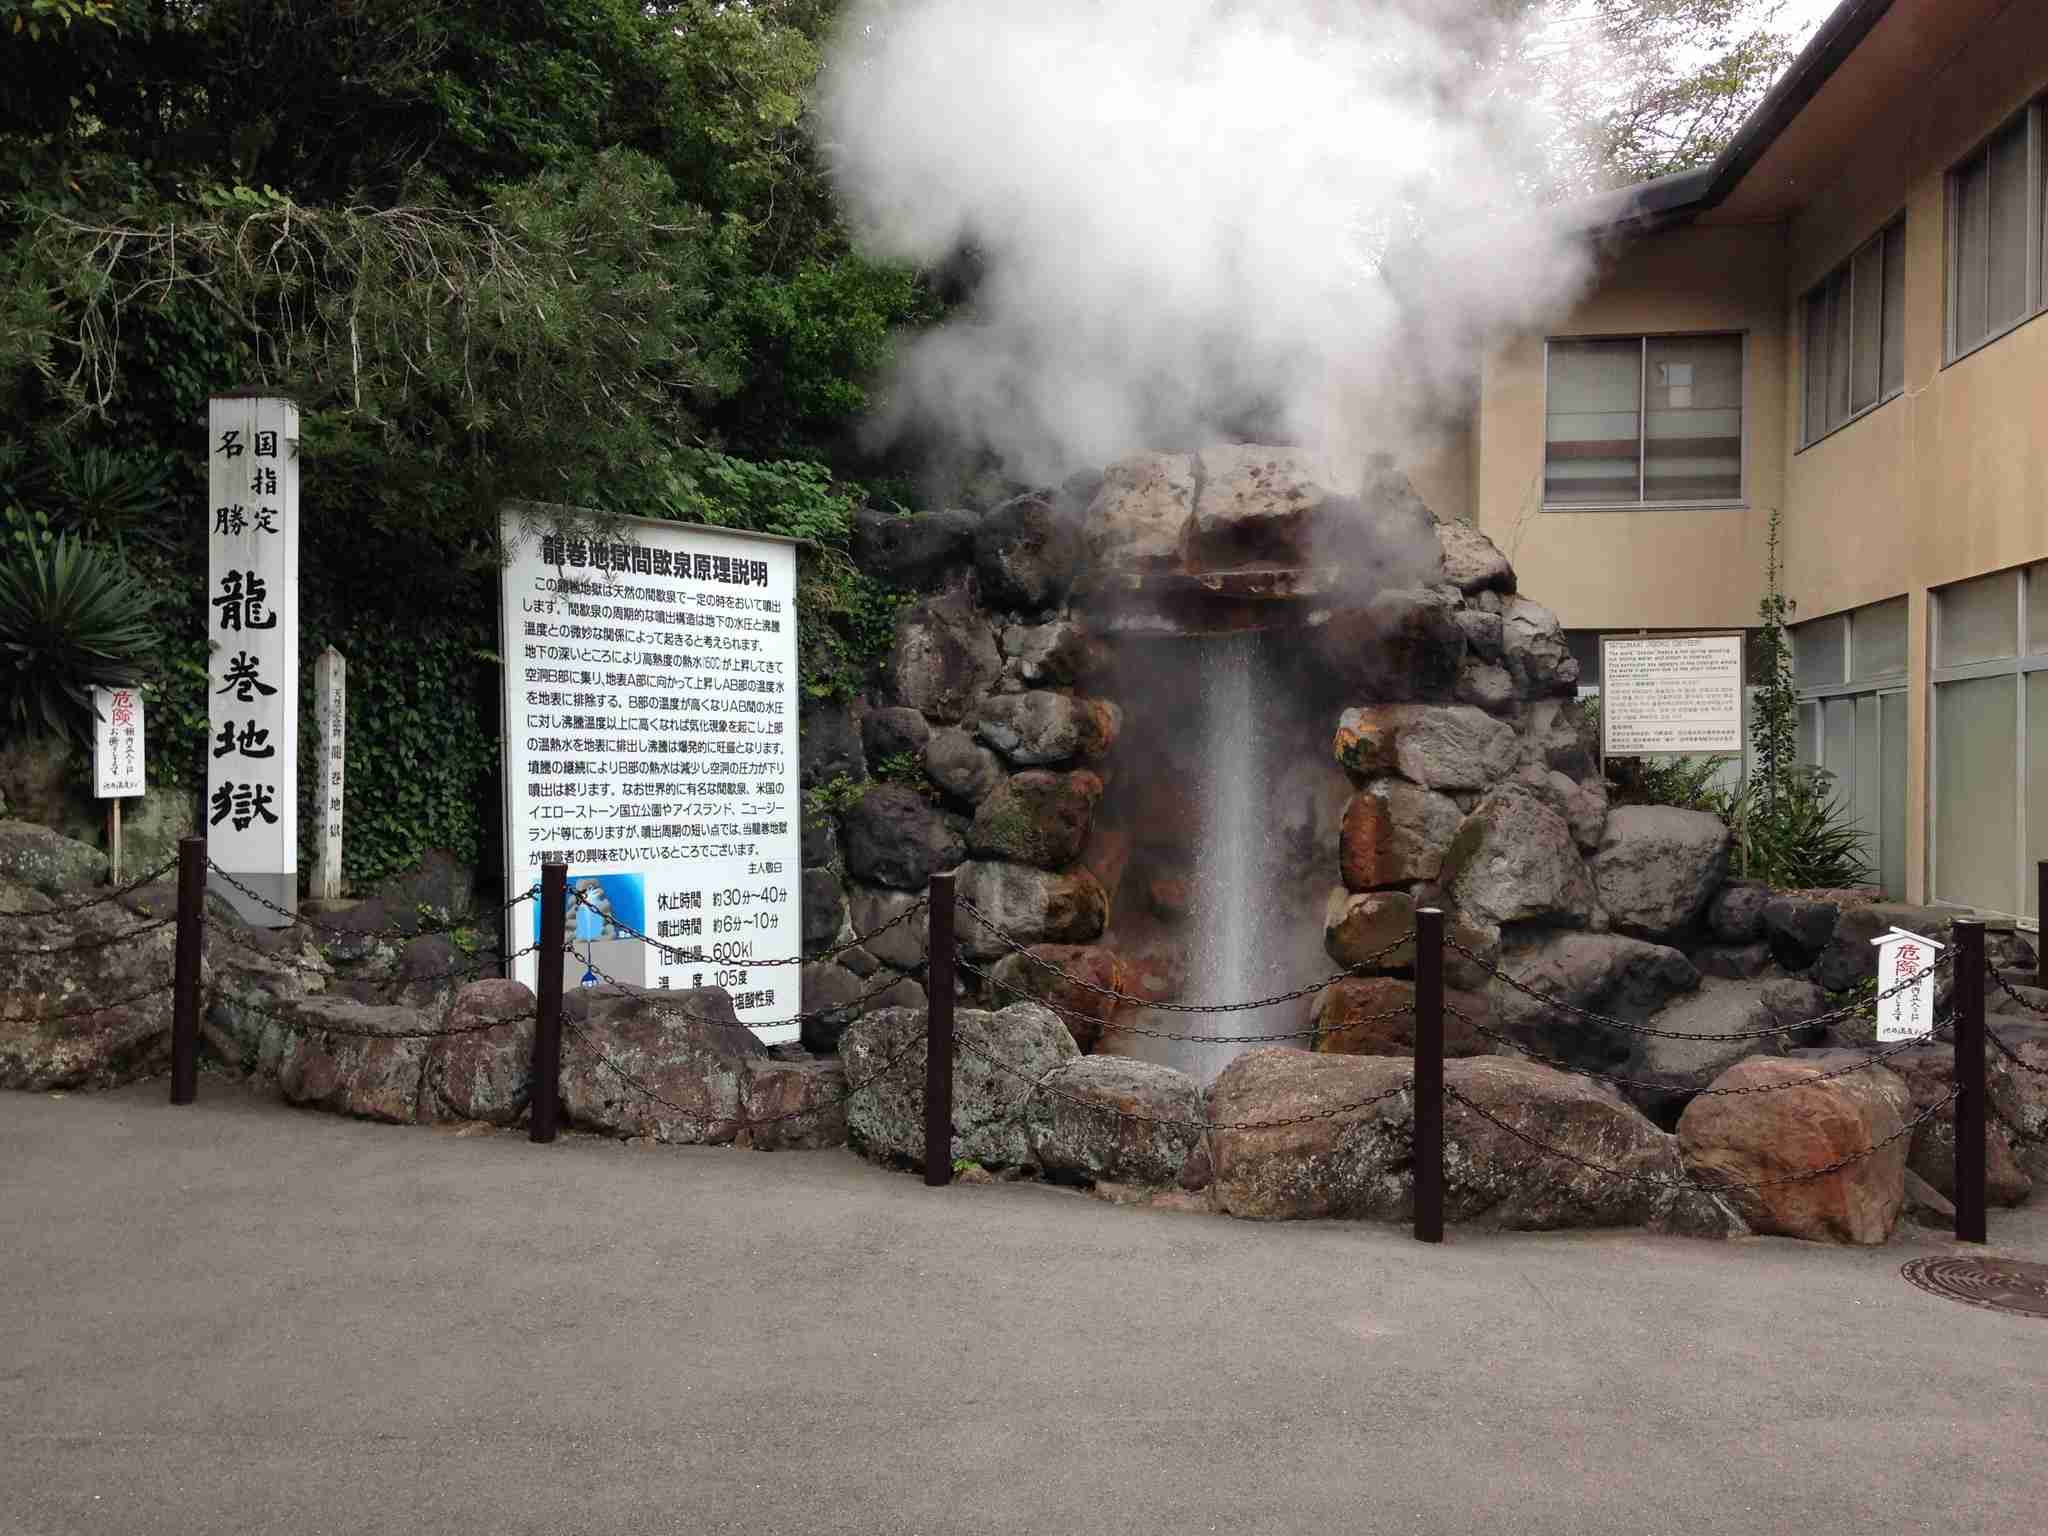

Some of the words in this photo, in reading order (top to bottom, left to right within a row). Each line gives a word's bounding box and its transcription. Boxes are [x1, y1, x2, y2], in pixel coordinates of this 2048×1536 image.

[214, 430, 249, 537] 名勝
[252, 431, 280, 535] 国指定
[112, 690, 133, 727] 危険
[210, 568, 280, 831] 龍巻地獄
[658, 891, 702, 912] 休止時間
[658, 917, 702, 938] 噴出時間
[1895, 944, 1920, 977] 危険
[714, 969, 748, 988] 105度
